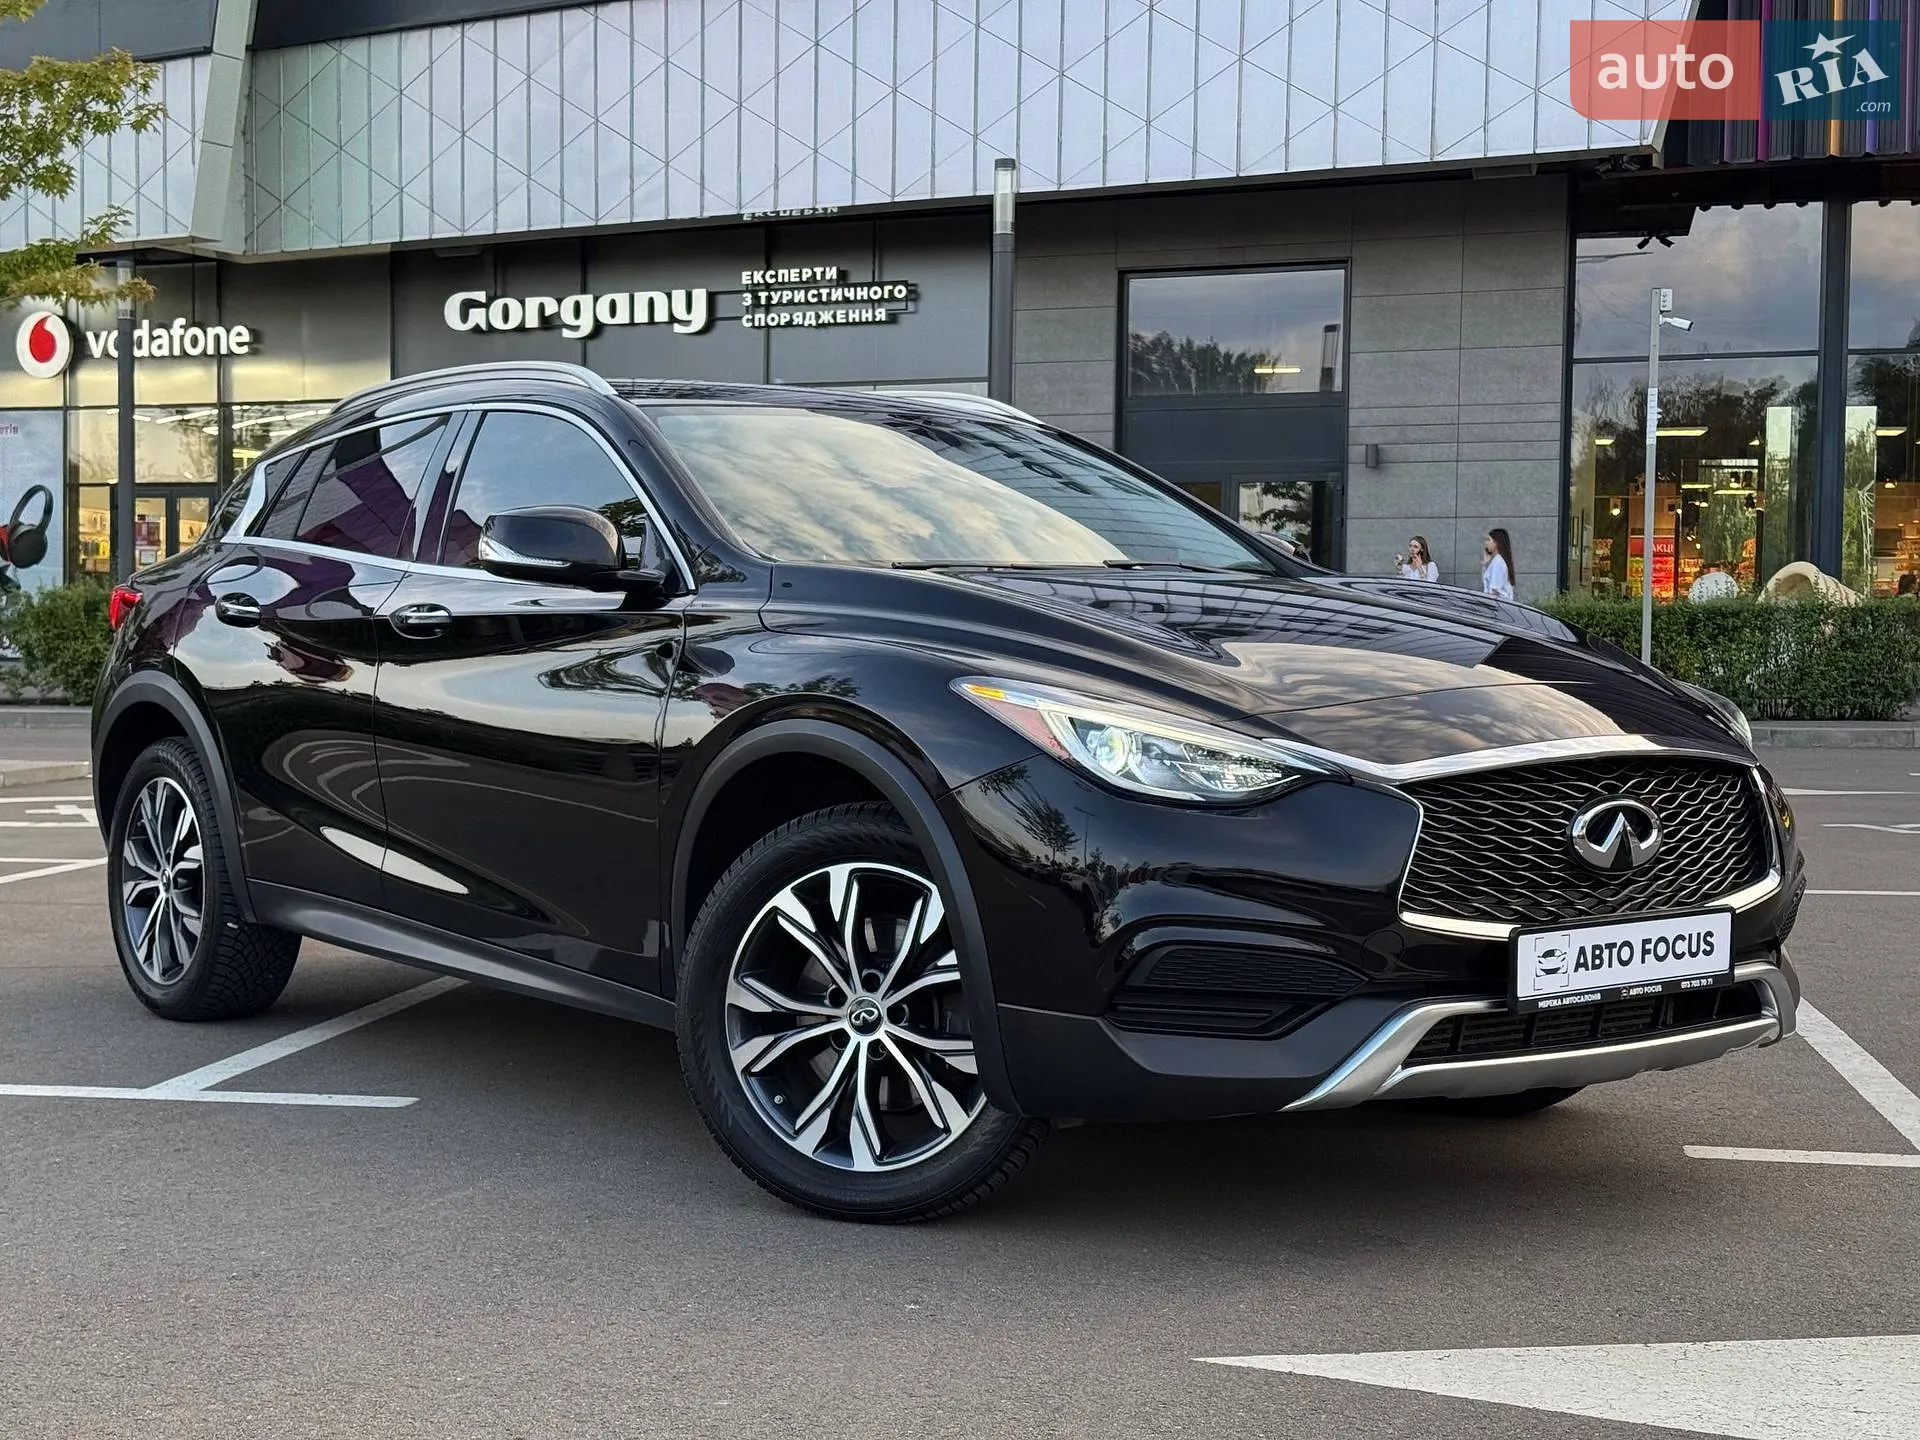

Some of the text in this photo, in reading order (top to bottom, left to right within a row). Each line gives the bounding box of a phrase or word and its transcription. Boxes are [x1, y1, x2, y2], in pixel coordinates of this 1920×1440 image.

[741, 266, 837, 285] ЕКСПЕРТИ
[758, 285, 907, 305] ТУРИСТИЧНОГО
[444, 288, 708, 338] Gorgany
[741, 308, 887, 328] СПОРЯДЖЕННЯ
[1574, 930, 1715, 973] АВТО FOCUS
[1644, 984, 1663, 994] FOCUS
